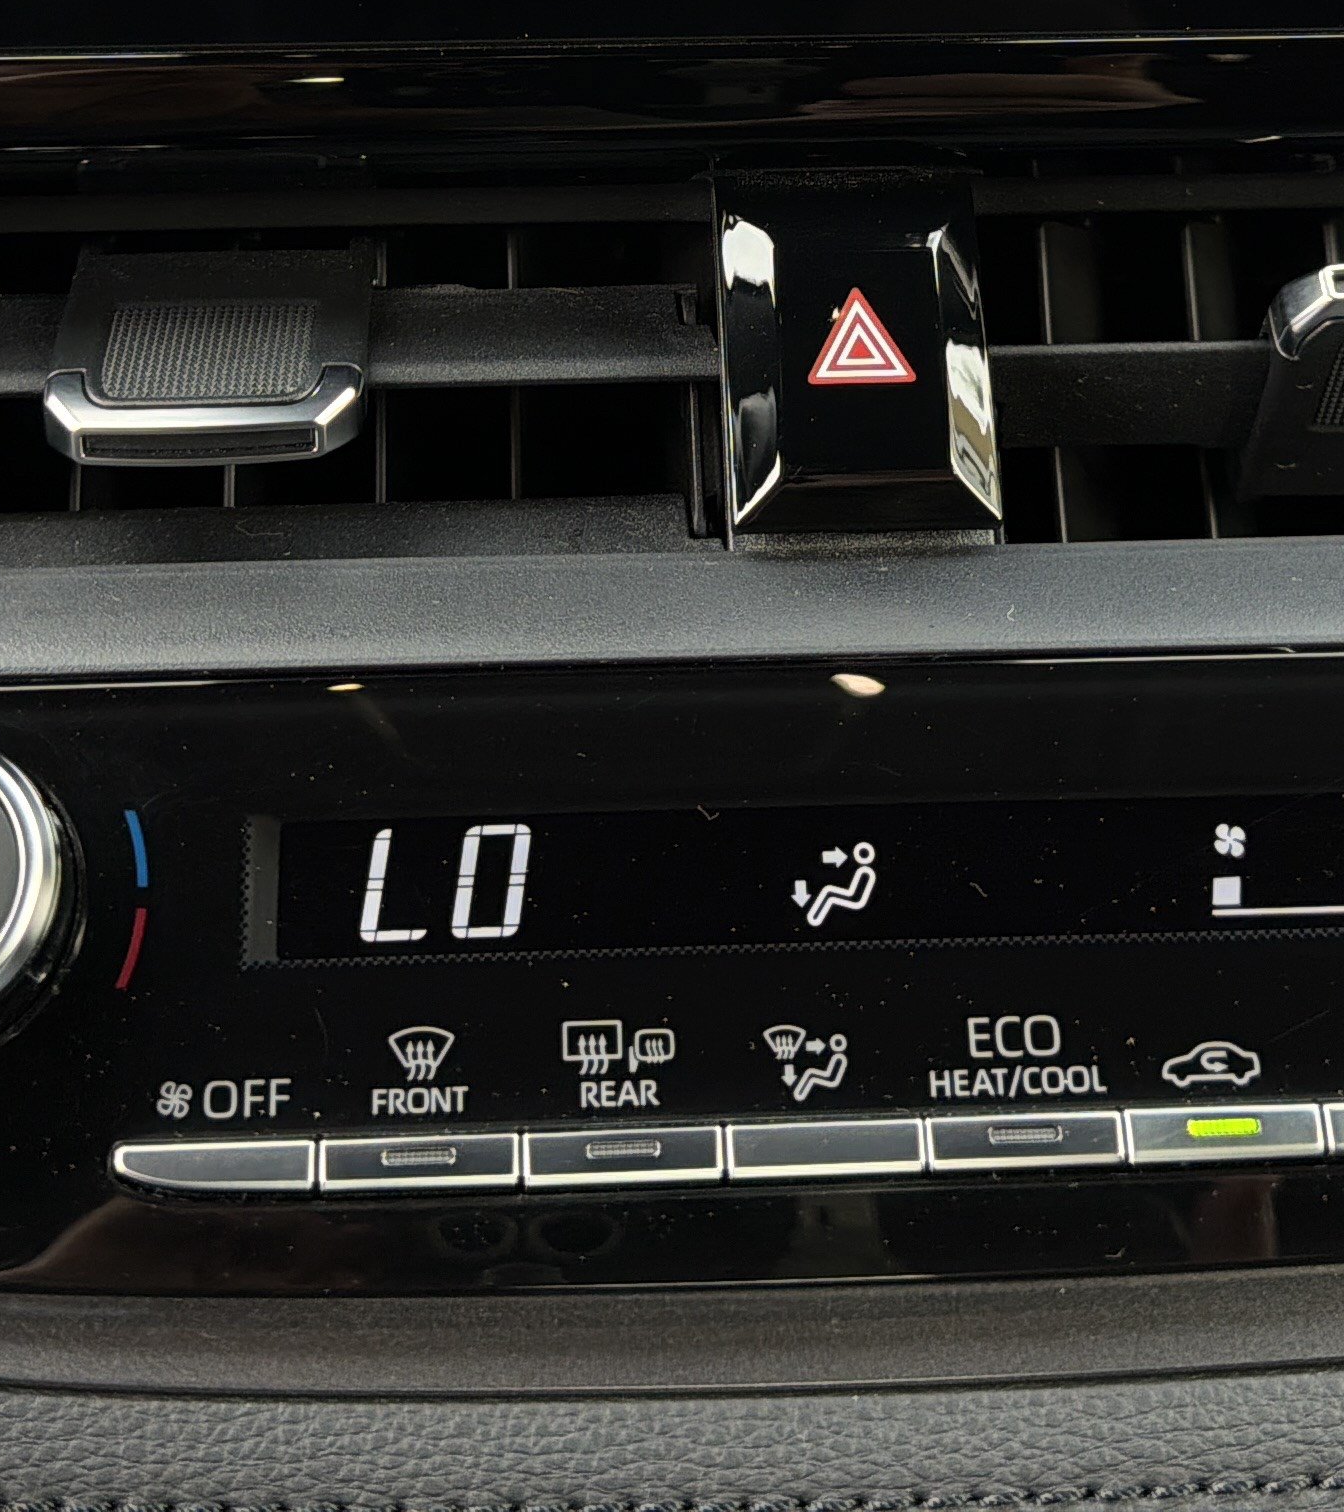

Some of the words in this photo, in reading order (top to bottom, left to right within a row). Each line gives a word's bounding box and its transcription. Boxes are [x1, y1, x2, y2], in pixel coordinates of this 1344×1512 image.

[360, 823, 532, 942] LO
[967, 1015, 1062, 1059] ECO
[203, 1078, 292, 1119] OFF
[579, 1080, 661, 1109] REAR
[928, 1065, 1107, 1098] HEAT/COOL
[371, 1086, 468, 1116] FRONT
